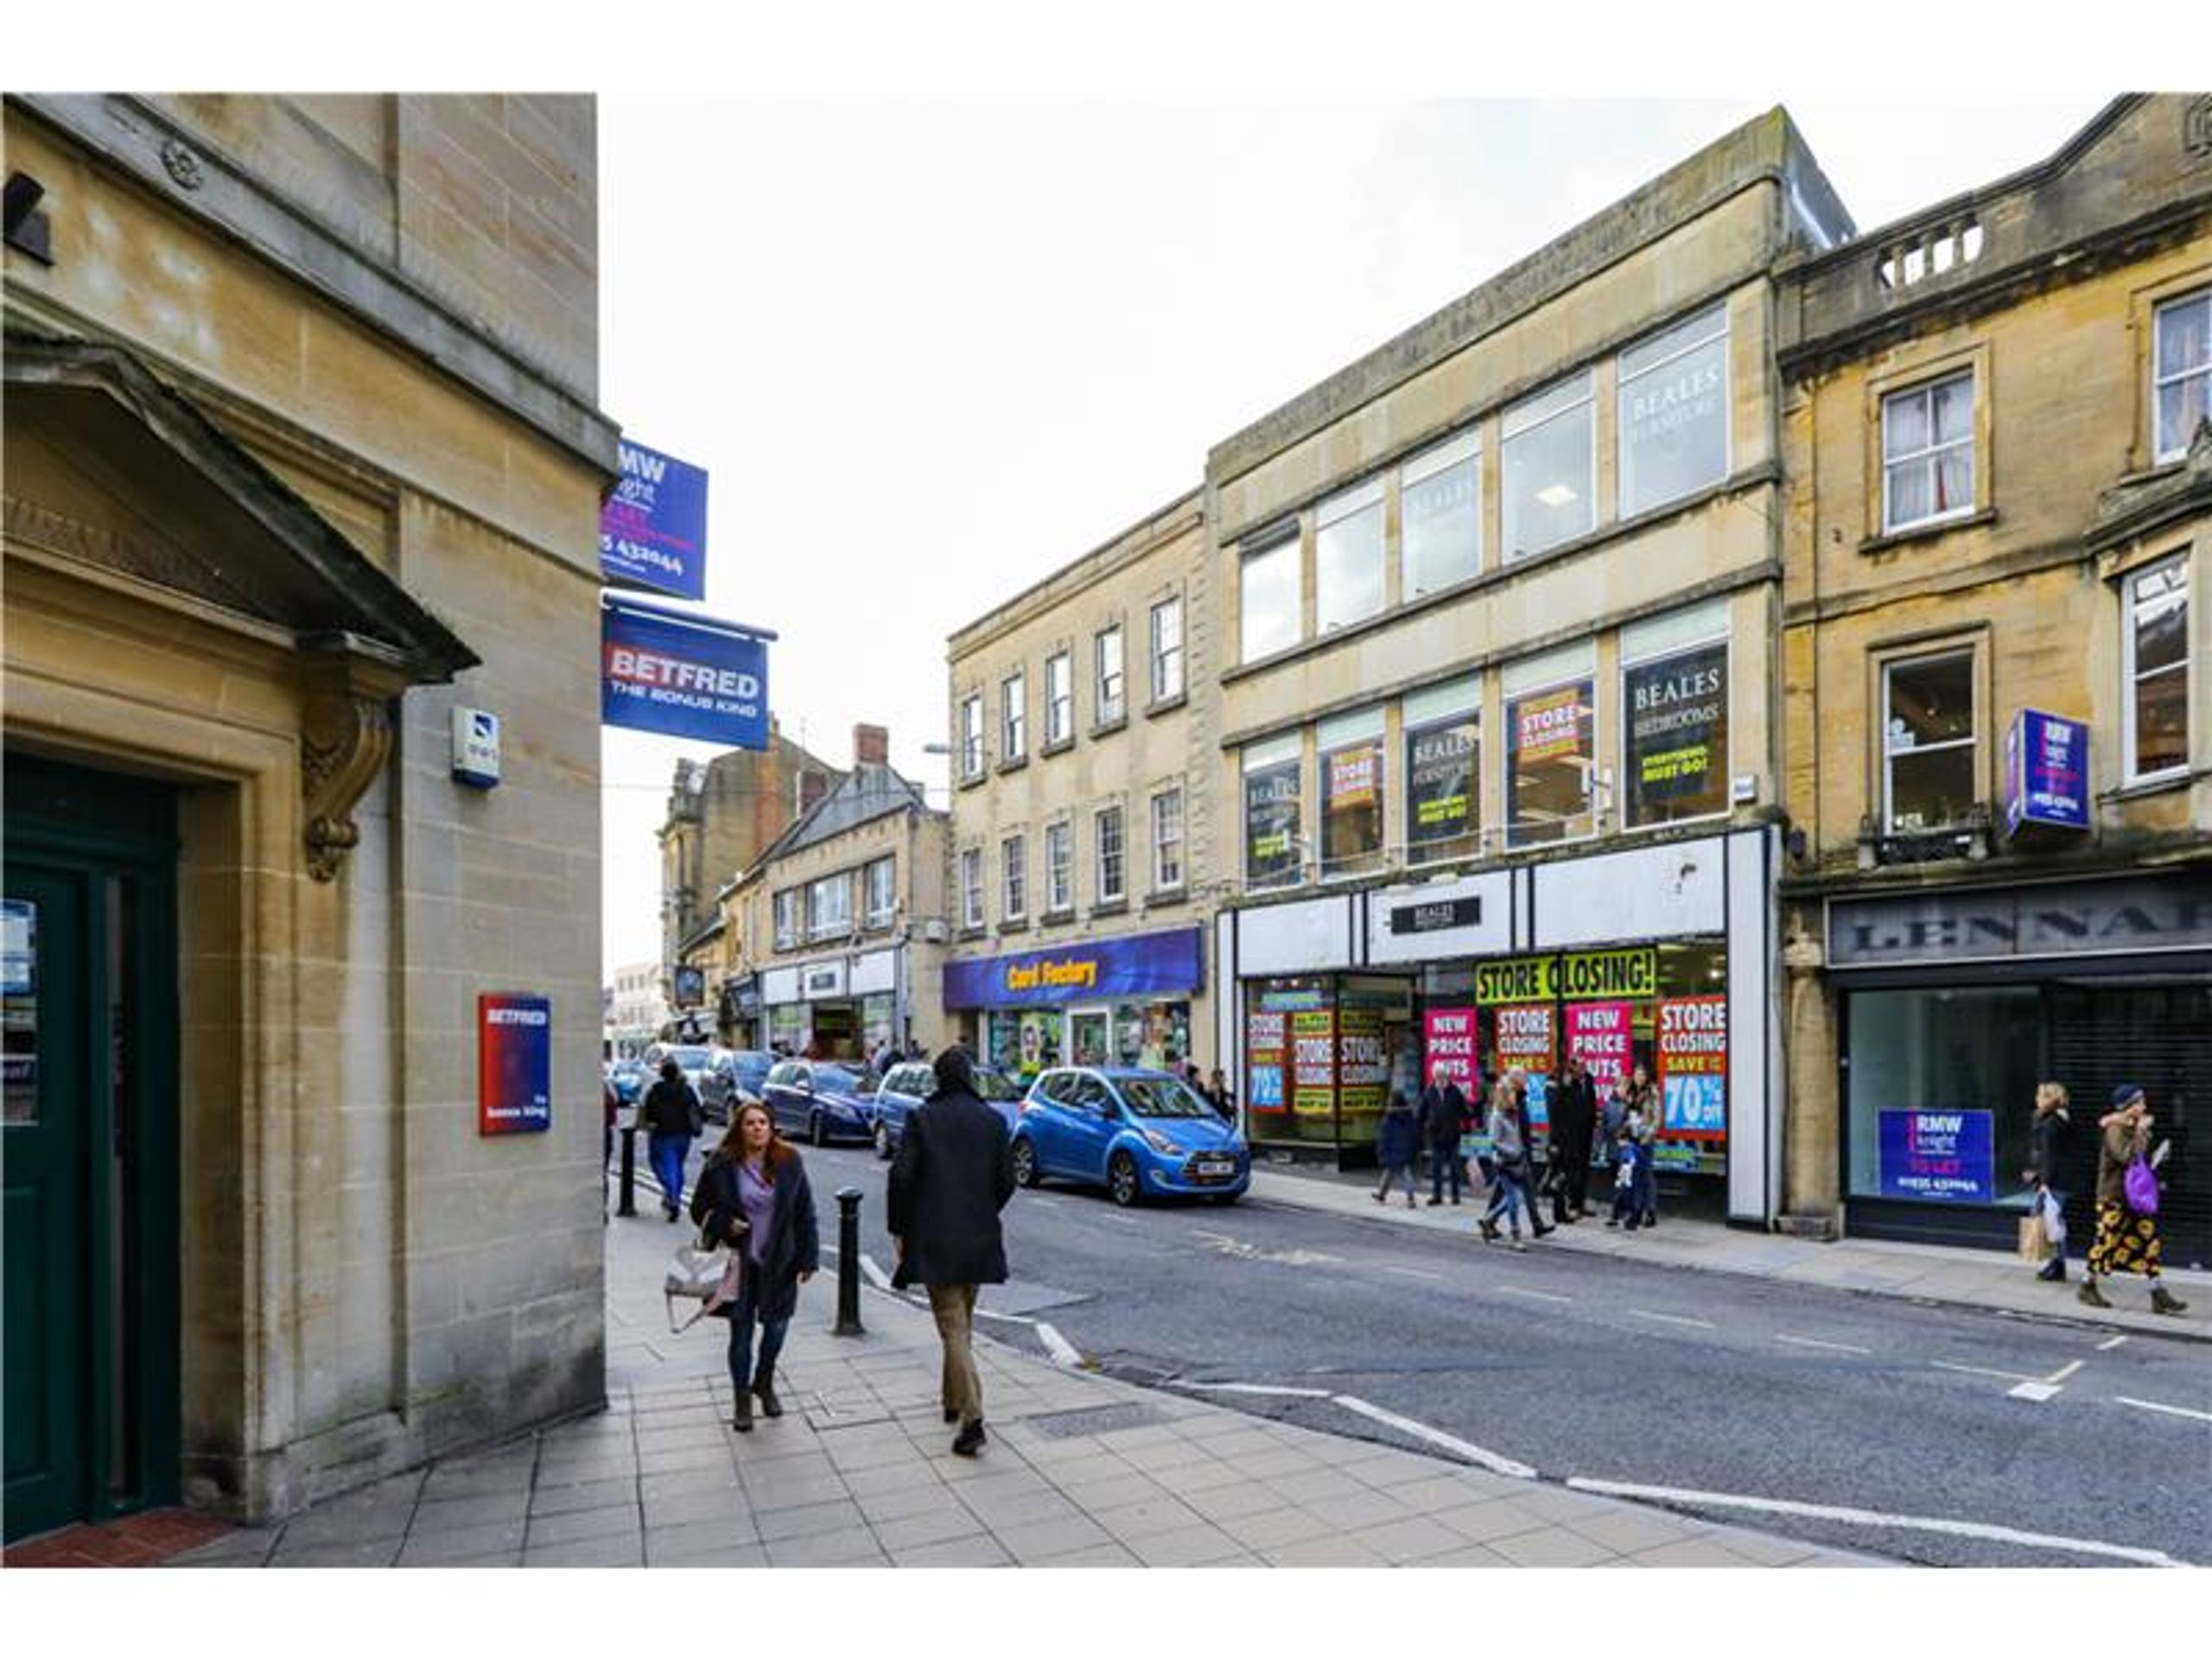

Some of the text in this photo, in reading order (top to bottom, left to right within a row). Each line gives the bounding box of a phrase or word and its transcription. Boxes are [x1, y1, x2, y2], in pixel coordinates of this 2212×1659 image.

[1634, 364, 1719, 423] BEALES
[611, 647, 760, 700] BETFRED
[611, 680, 645, 698] THE
[650, 688, 712, 709] BONUS
[1636, 668, 1719, 709] BEALES
[1007, 958, 1097, 992] Card Factory
[1478, 951, 1653, 1000] STORE CLOSING!
[486, 1008, 547, 1027] BETFRED
[1433, 1014, 1467, 1034] NEW
[1500, 1010, 1549, 1034] STORE
[1578, 1007, 1619, 1030] NEW
[1661, 1002, 1726, 1030] STORE
[1296, 1038, 1332, 1063] STORE
[1429, 1036, 1471, 1055] PRICE
[1499, 1037, 1549, 1055] CLOSING
[1573, 1034, 1626, 1054] PRICE
[1661, 1033, 1726, 1052] CLOSING
[1667, 1056, 1704, 1071] SAVE
[1916, 1114, 1962, 1133] RMW
